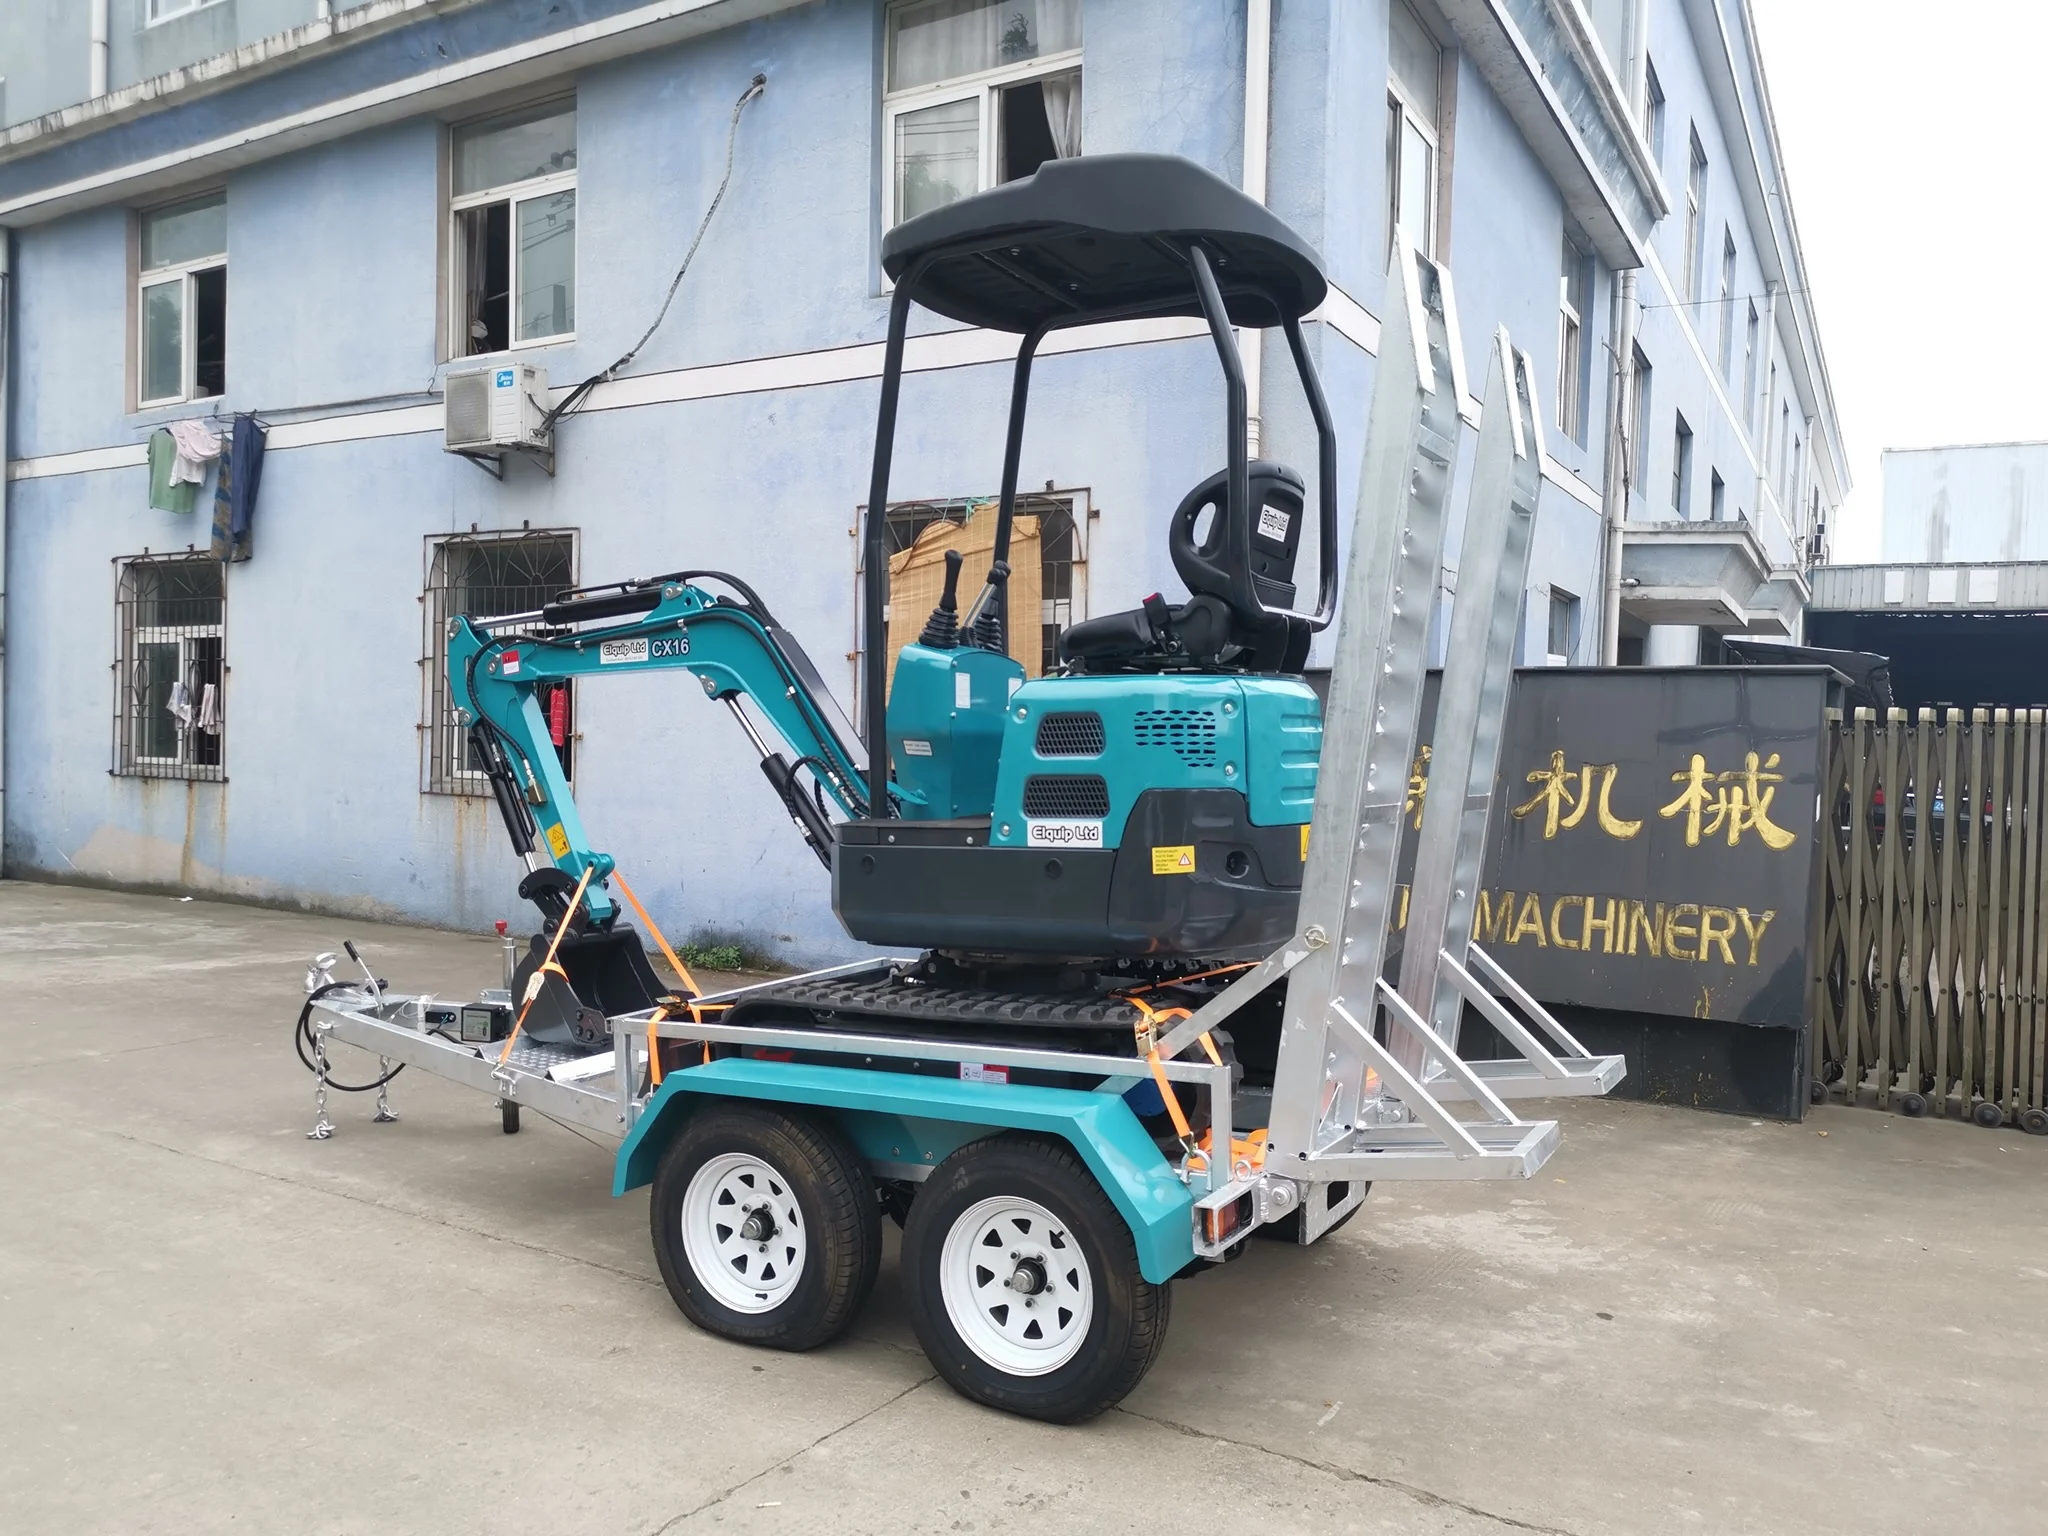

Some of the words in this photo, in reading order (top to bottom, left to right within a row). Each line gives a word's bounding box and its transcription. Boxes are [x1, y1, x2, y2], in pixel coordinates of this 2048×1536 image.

[603, 644, 631, 657] Elquip
[631, 641, 647, 654] Ltd
[651, 638, 690, 658] CX16
[1032, 825, 1074, 843] Elquip
[1075, 825, 1099, 841] Ltd
[1473, 888, 1778, 966] MACHINERY
